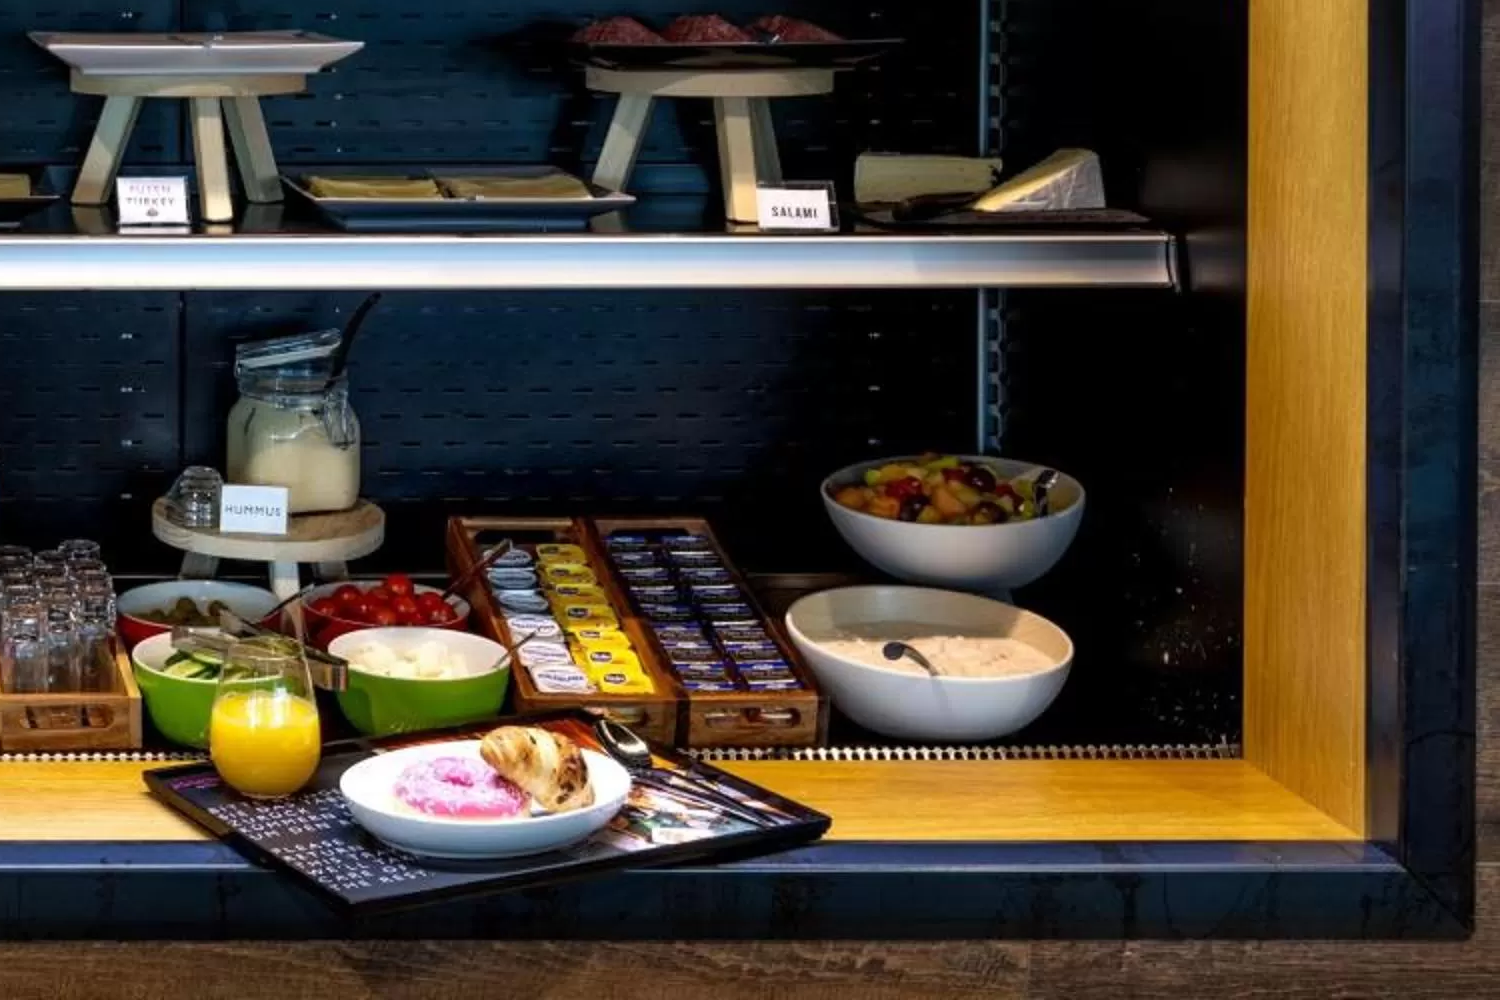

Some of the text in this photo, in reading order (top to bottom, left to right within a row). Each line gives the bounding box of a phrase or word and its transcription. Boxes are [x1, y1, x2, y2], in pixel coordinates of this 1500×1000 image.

[126, 196, 175, 207] TURKEY
[771, 205, 819, 218] SALAMI
[224, 504, 282, 517] HUMMUS
